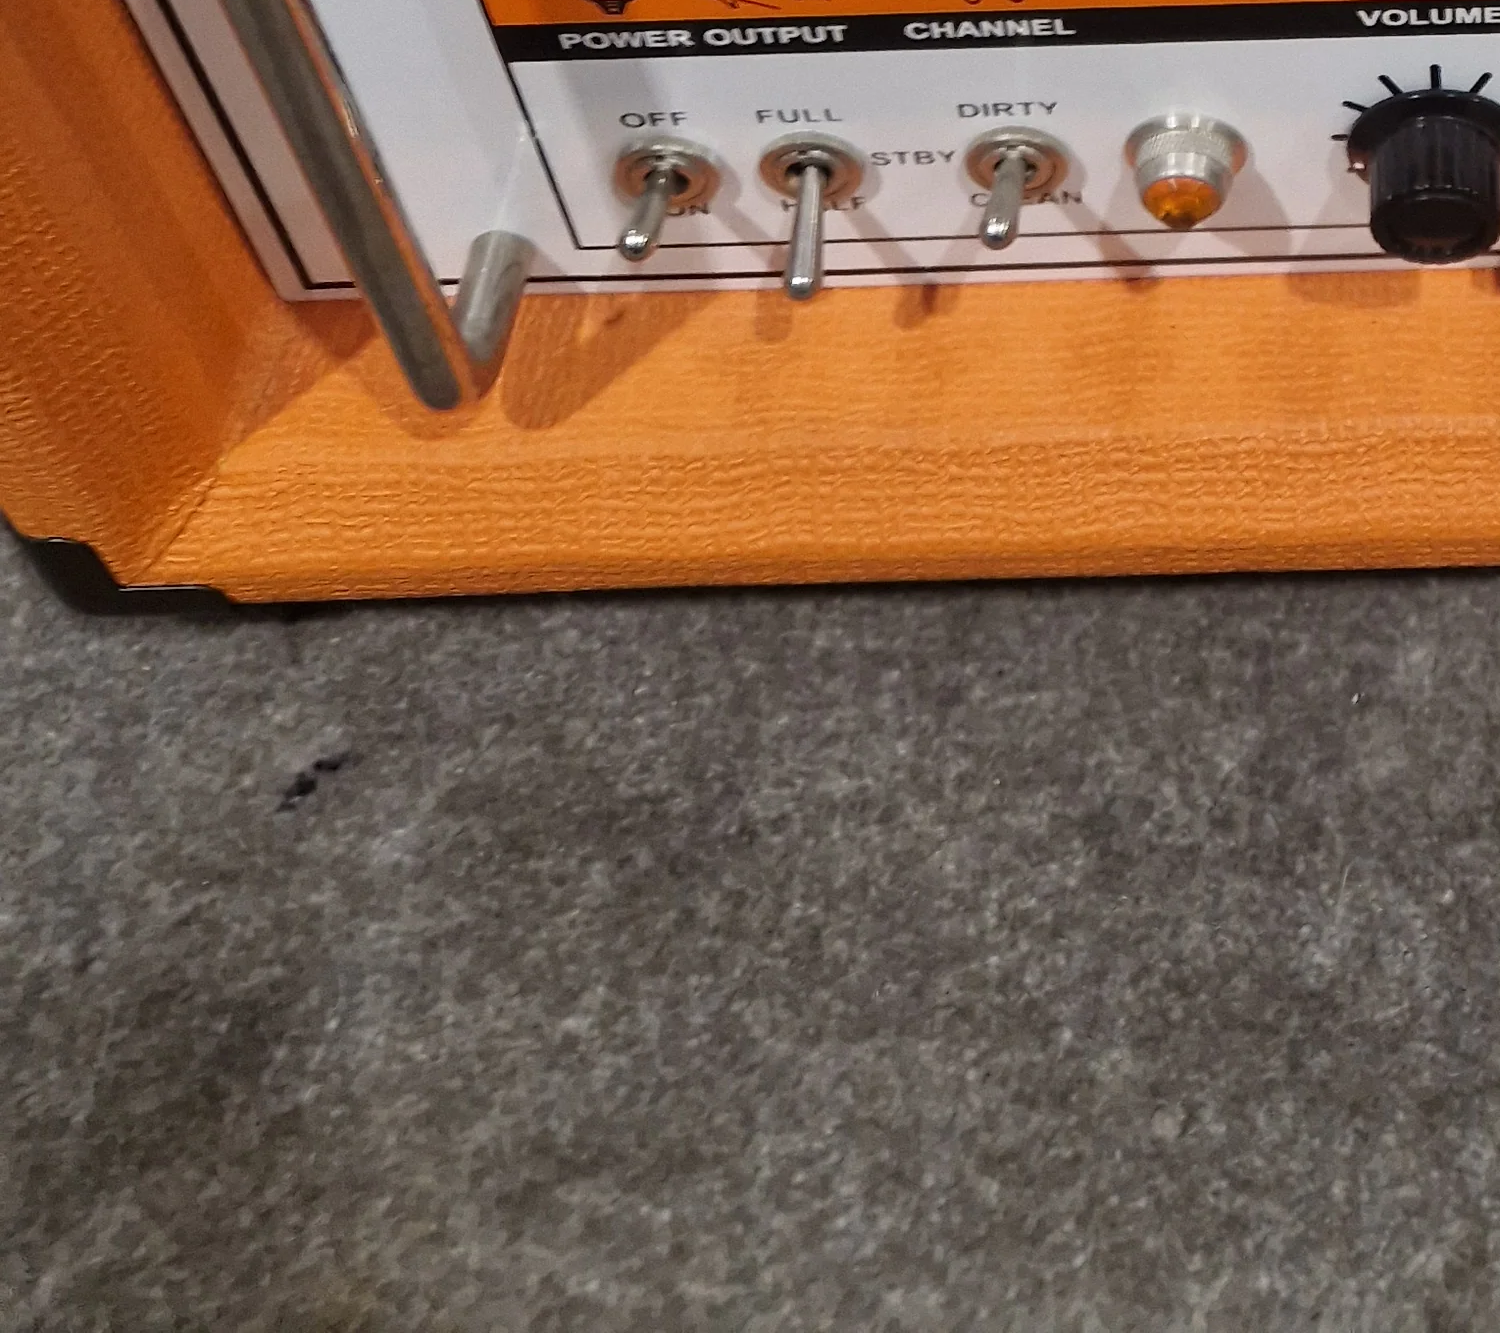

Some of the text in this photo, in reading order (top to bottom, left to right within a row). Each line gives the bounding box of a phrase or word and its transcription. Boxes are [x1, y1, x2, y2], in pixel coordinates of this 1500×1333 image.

[703, 24, 848, 47] OUTPUT
[903, 19, 1077, 41] CHANNEL
[558, 29, 695, 51] POWER
[755, 108, 844, 124] FULL
[956, 101, 1059, 118] DIRTY
[619, 111, 688, 129] OFF
[870, 149, 957, 167] STBY
